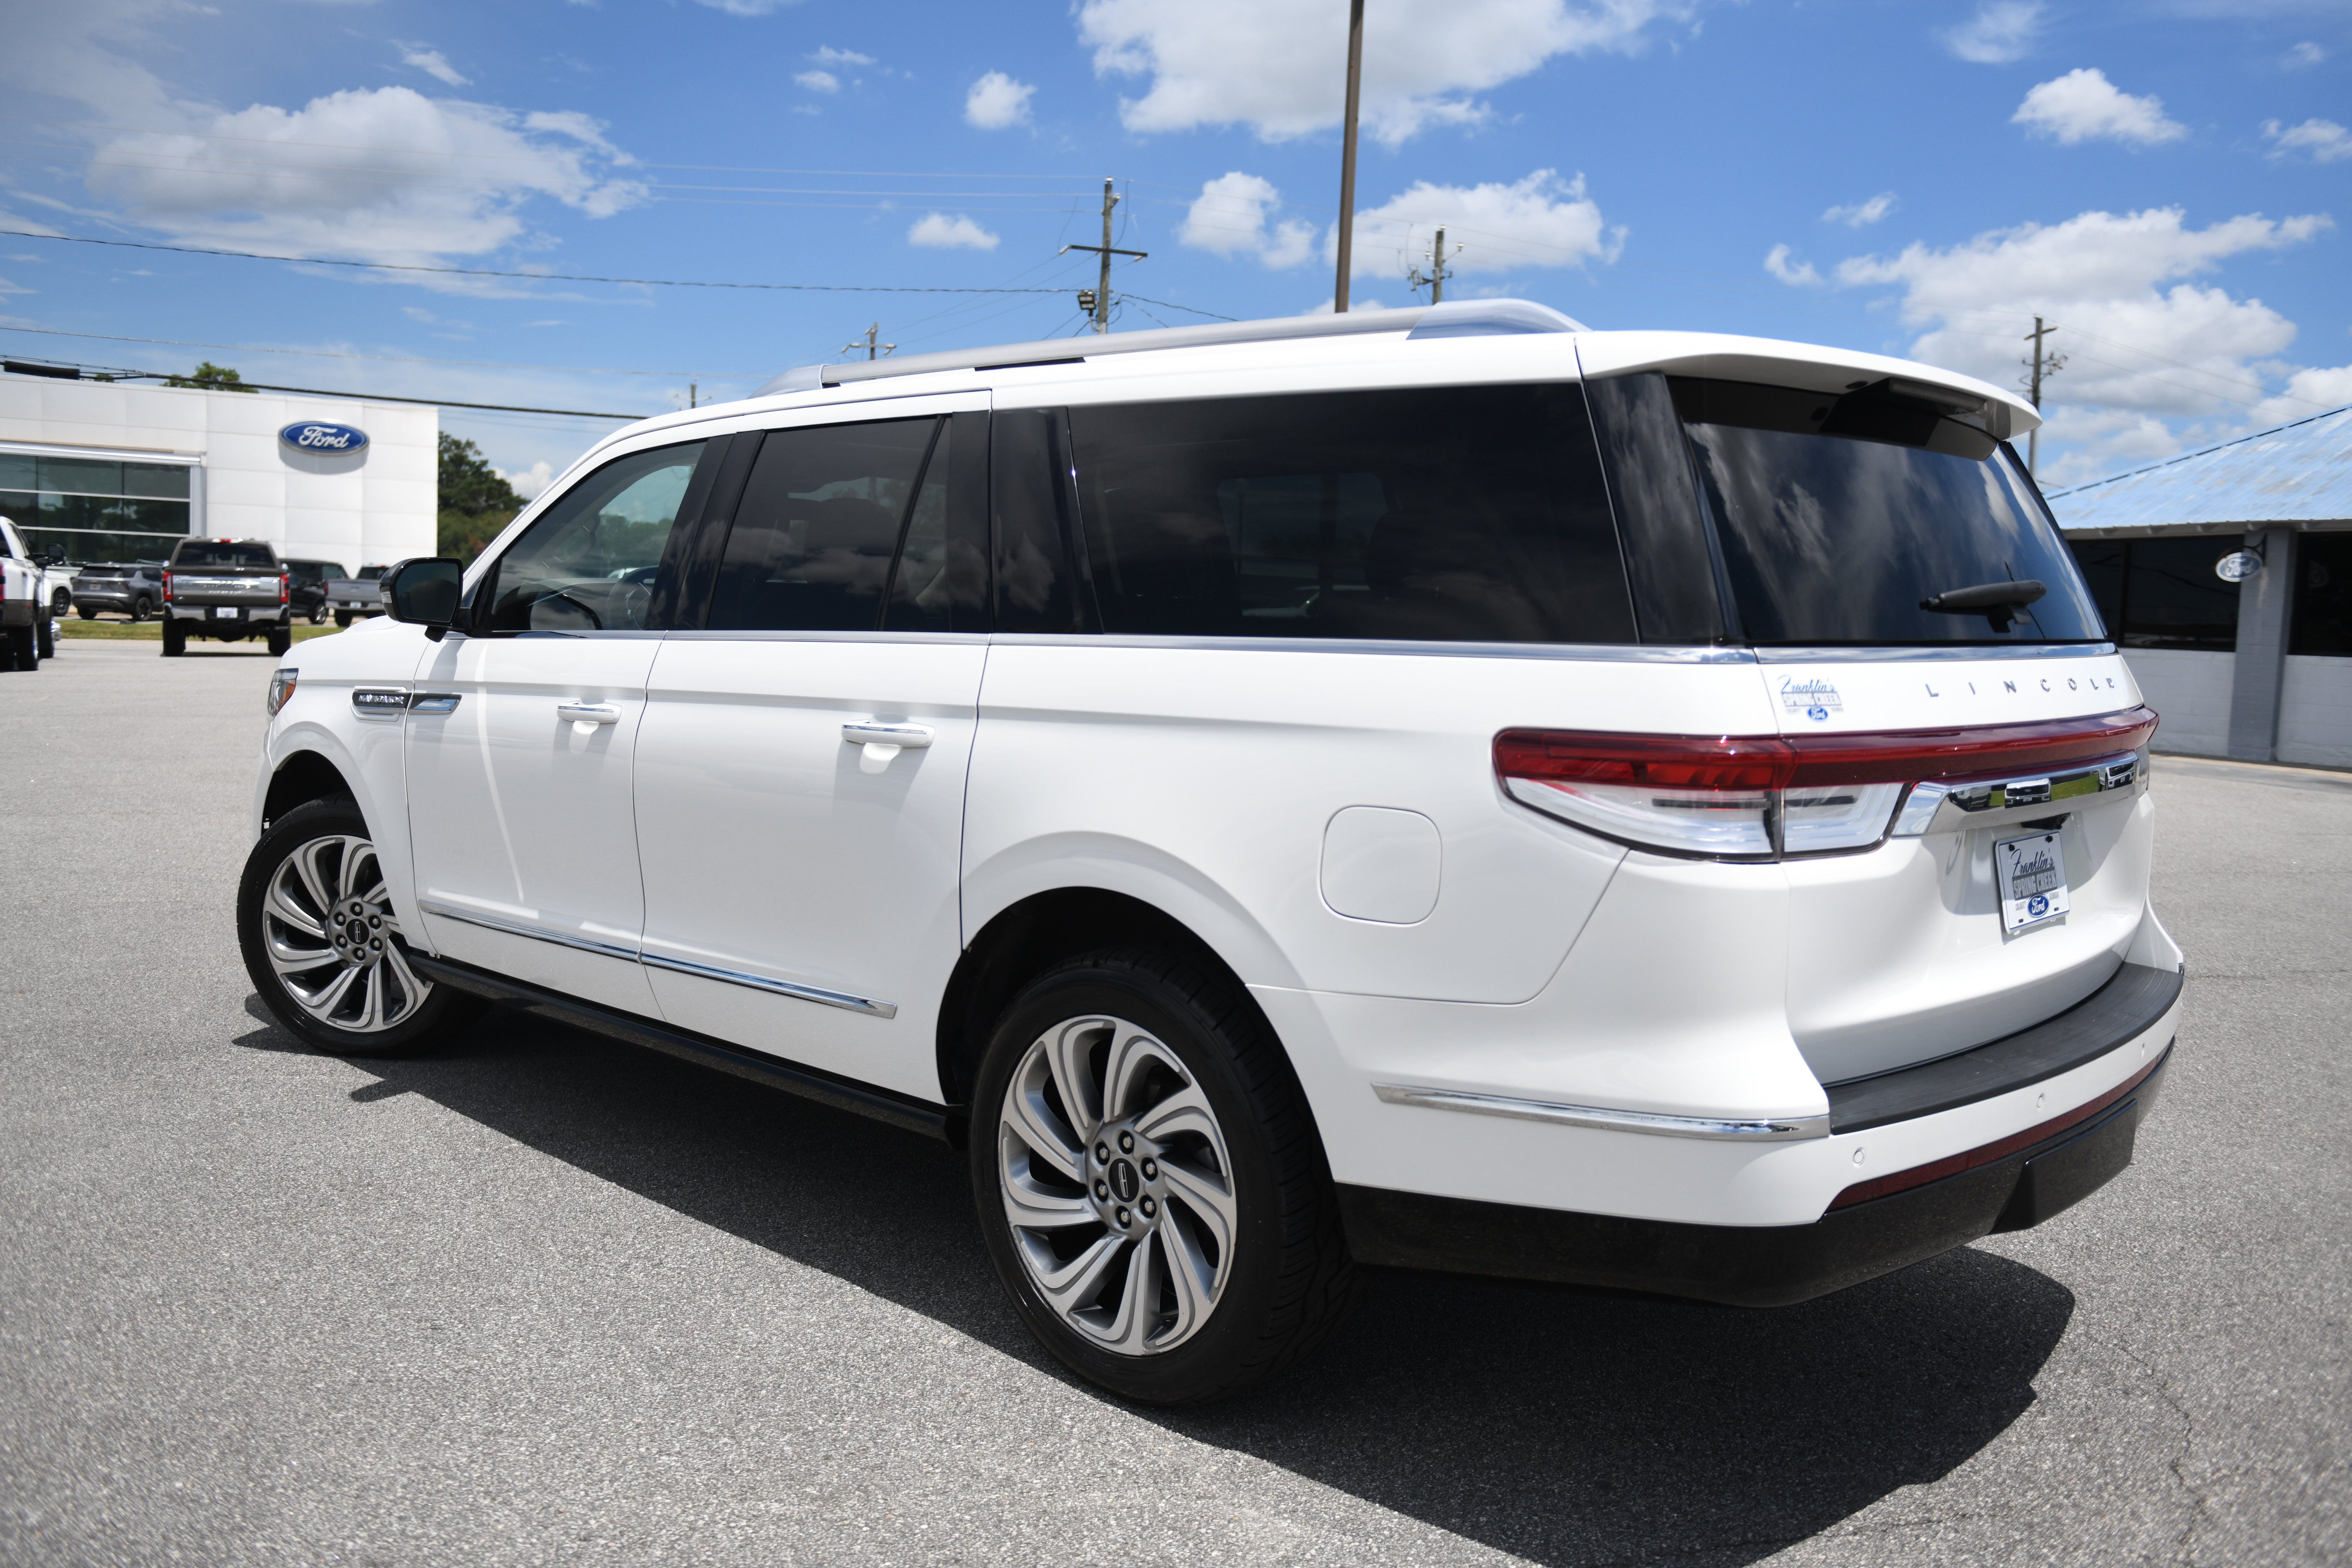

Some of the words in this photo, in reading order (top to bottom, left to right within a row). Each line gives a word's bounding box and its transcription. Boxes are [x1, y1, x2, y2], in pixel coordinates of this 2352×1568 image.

[298, 426, 350, 448] Ford
[2226, 558, 2254, 577] Ford
[1777, 675, 1835, 692] Franklin's
[1925, 678, 2115, 697] LINCOLN
[359, 694, 404, 704] NAVIGATOR
[1811, 707, 1826, 719] Ford
[2011, 848, 2054, 877] Franklin's
[2013, 875, 2036, 898] SPRING
[2037, 870, 2057, 892] CREEK
[2031, 897, 2045, 914] Ford
